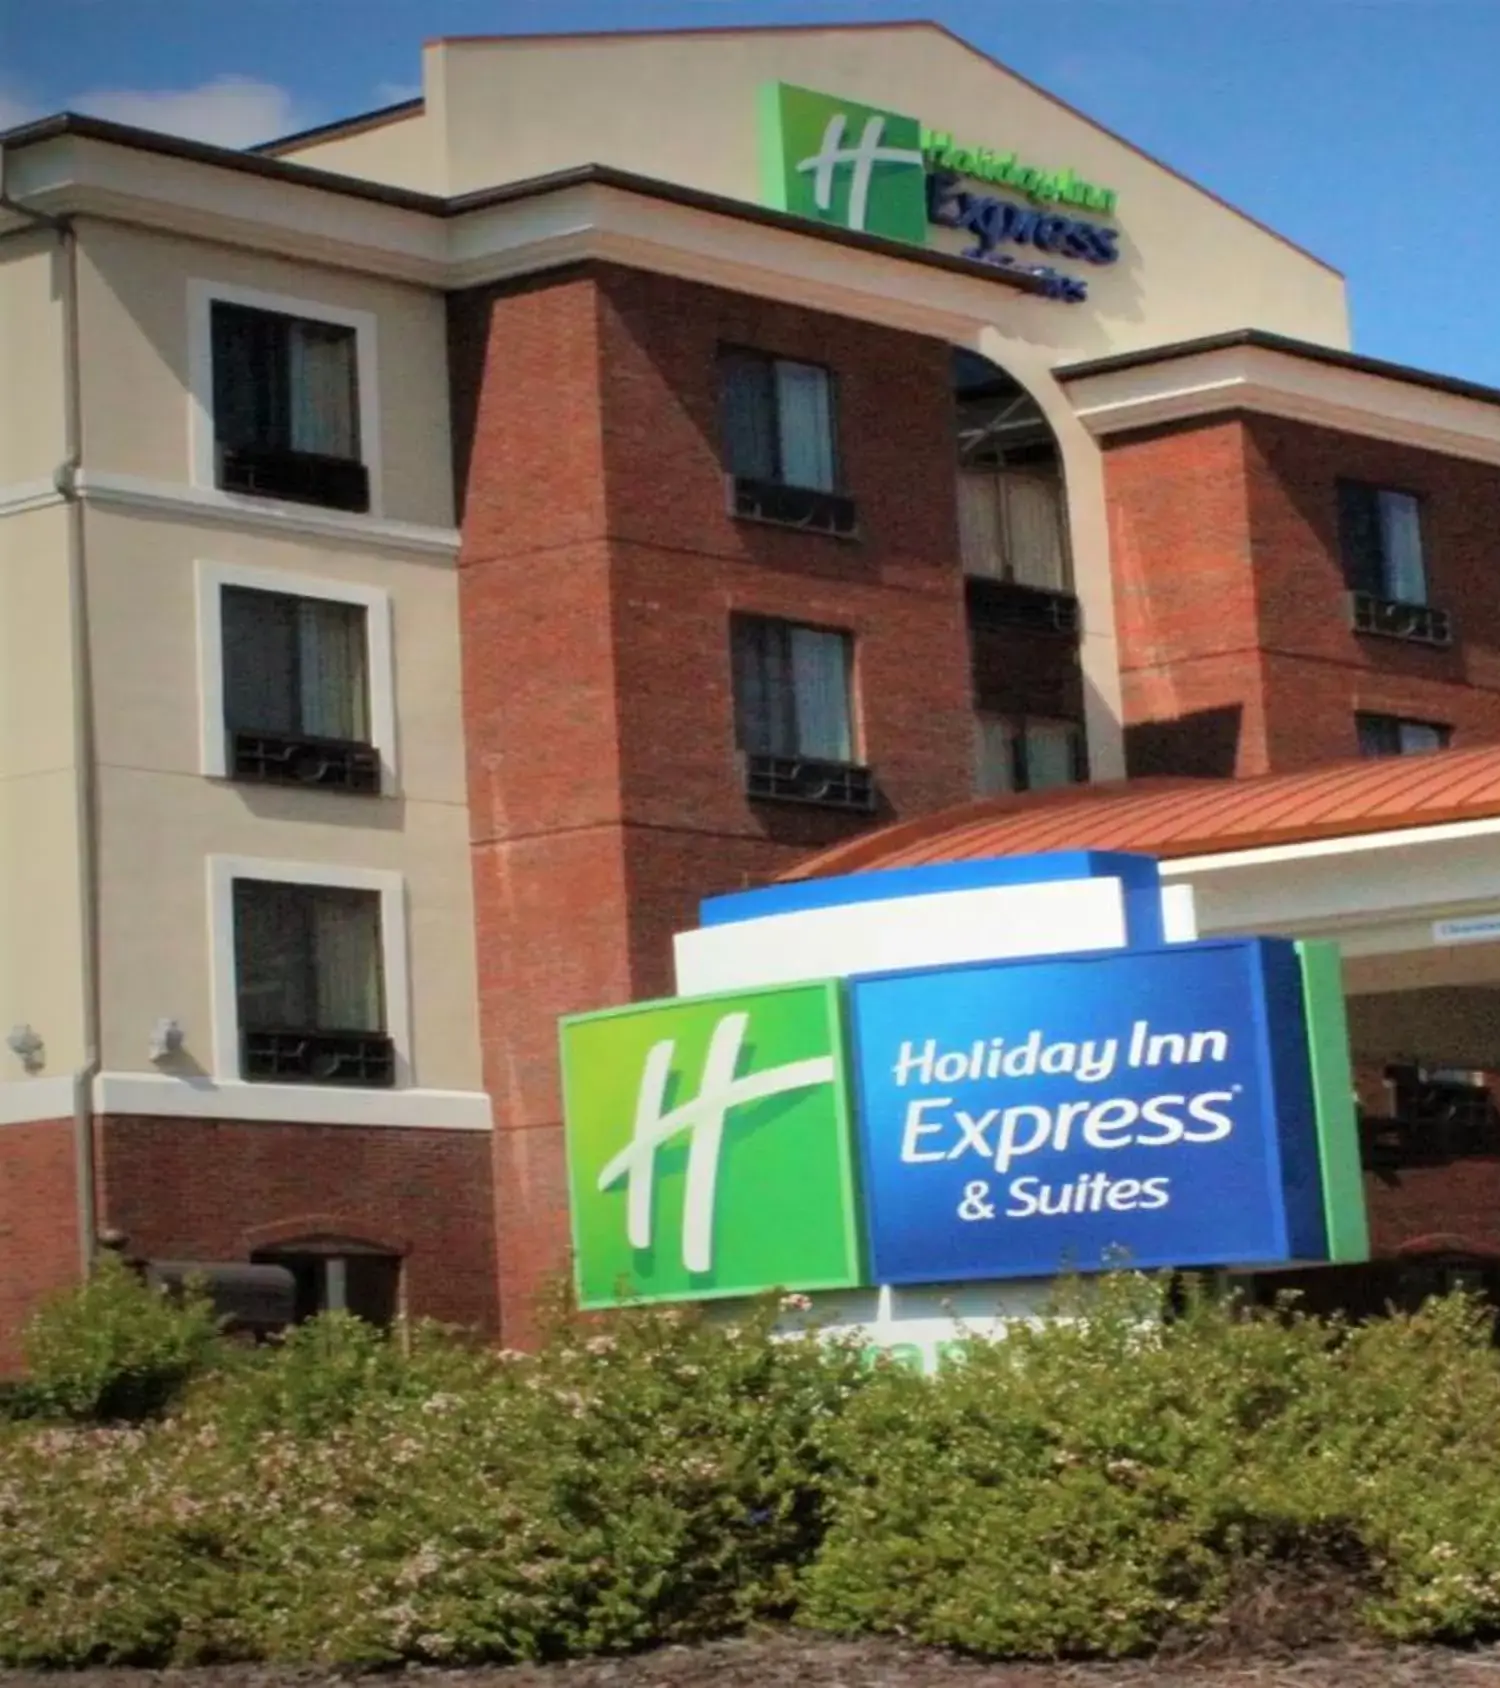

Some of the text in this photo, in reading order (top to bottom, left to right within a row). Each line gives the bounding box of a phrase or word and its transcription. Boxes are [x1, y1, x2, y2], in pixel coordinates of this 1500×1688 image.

[921, 129, 1058, 205] Holiday
[925, 171, 1119, 265] Express
[892, 1020, 1228, 1086] Holiday Inn
[899, 1090, 1234, 1174] Express
[956, 1173, 1171, 1222] & Suites
